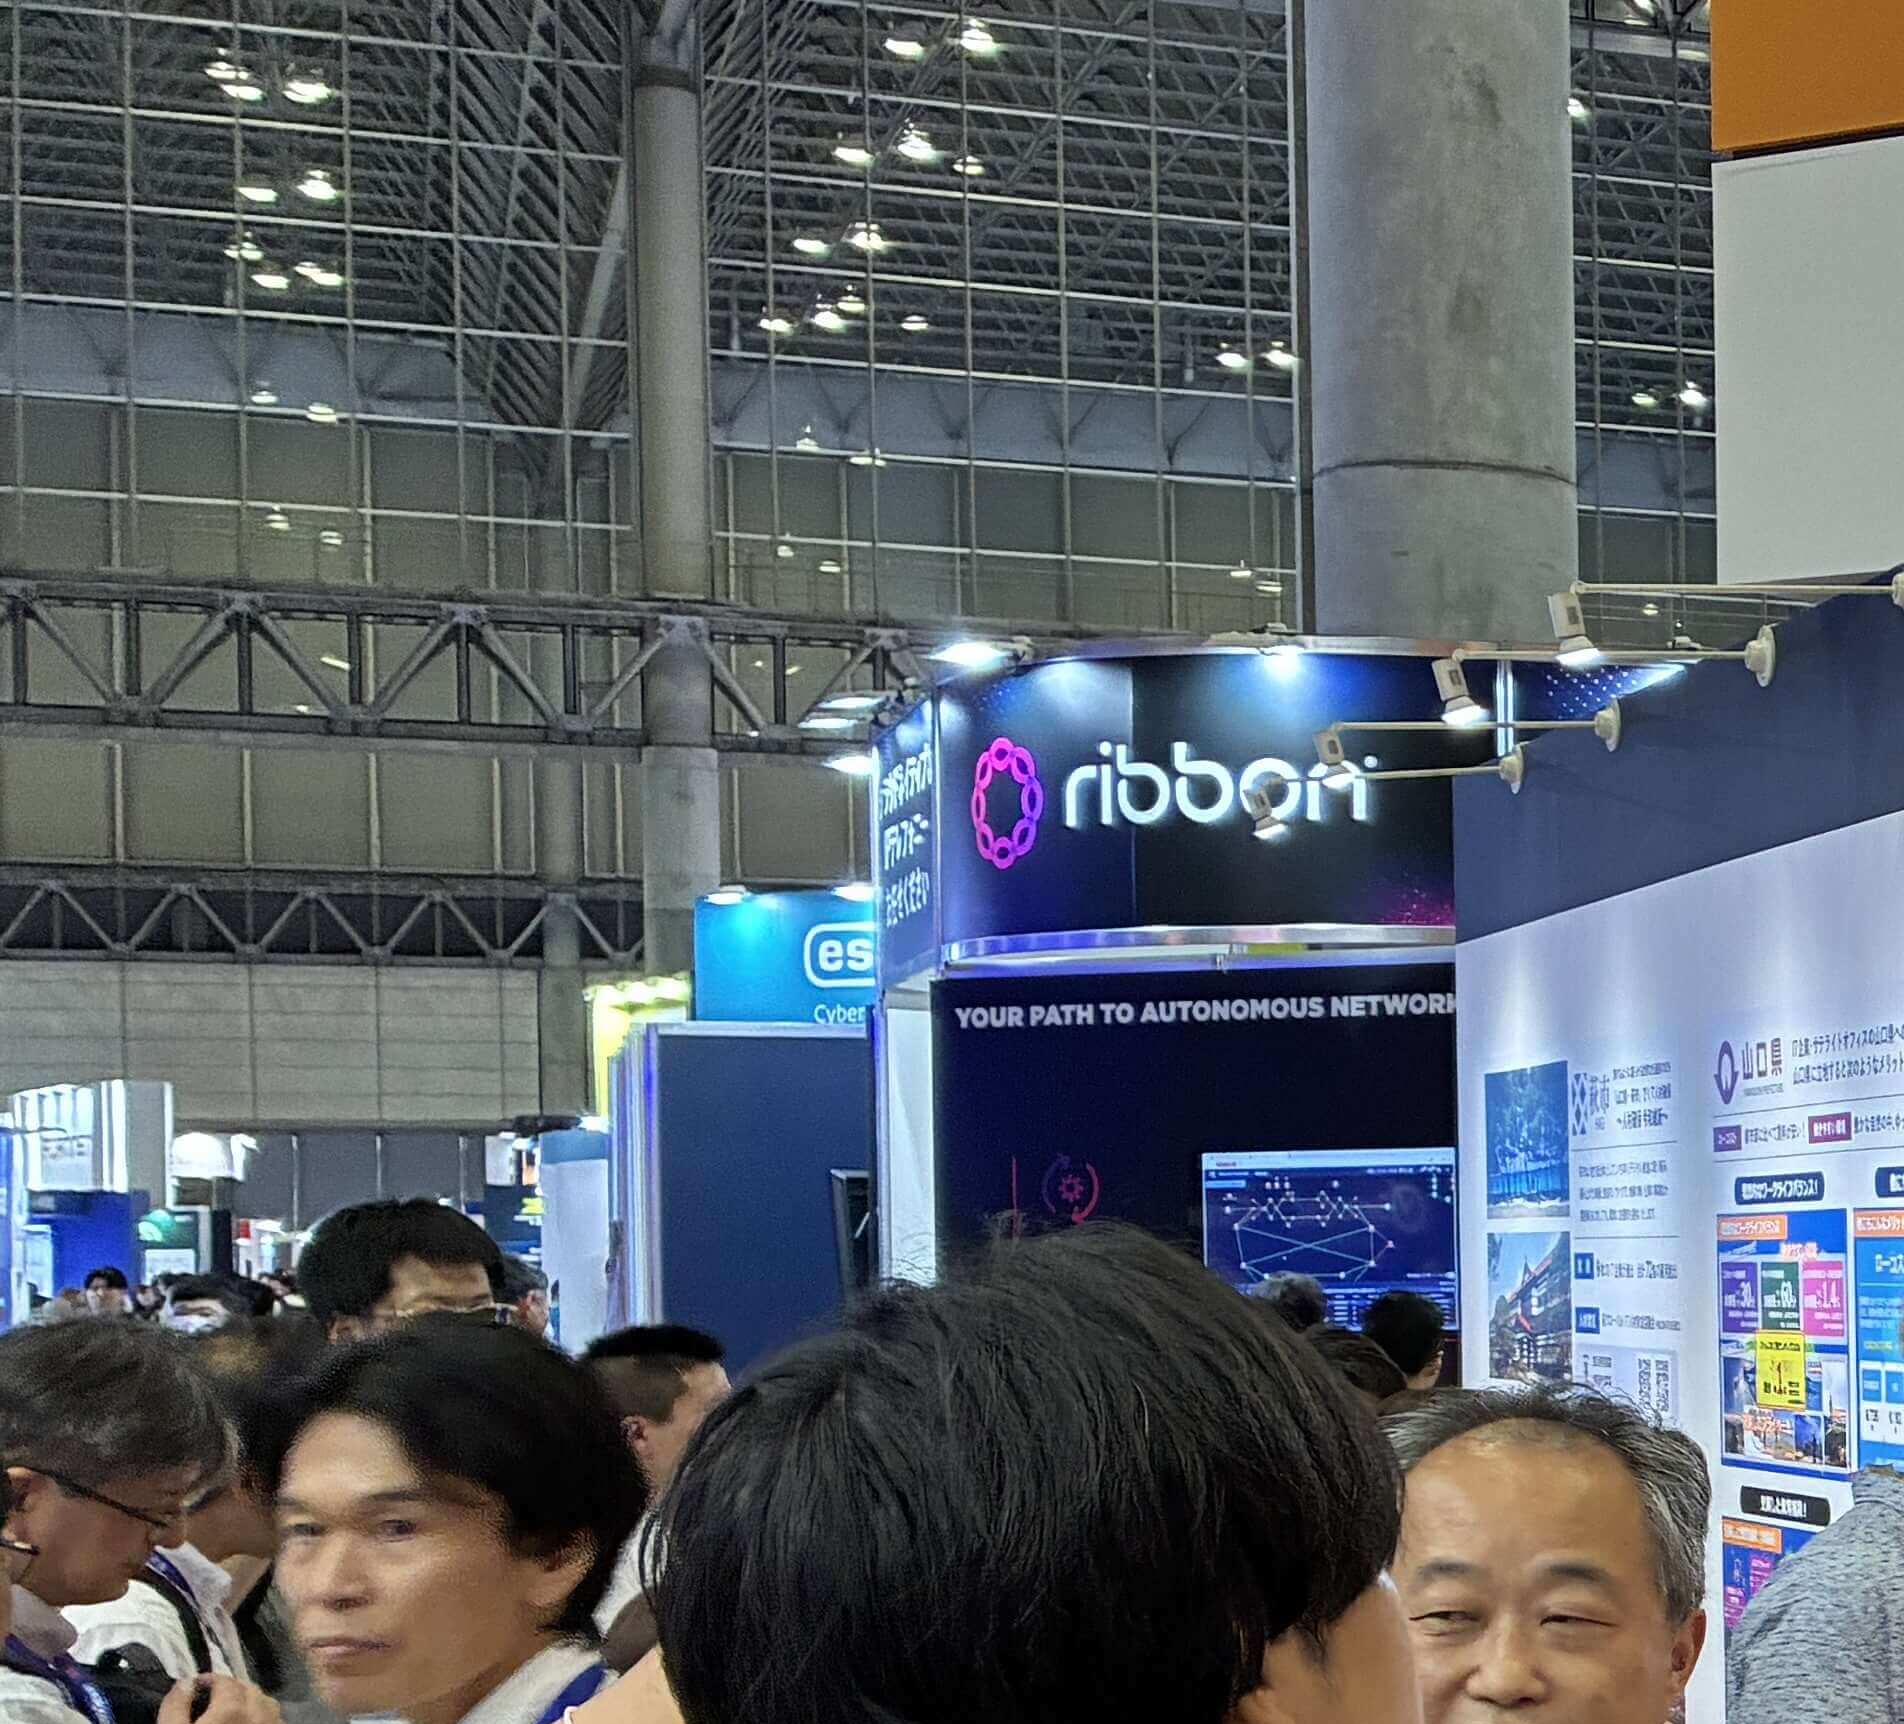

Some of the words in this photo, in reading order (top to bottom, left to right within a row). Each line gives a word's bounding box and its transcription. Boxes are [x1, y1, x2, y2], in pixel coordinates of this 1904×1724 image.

[1064, 740, 1370, 830] ribbon
[819, 939, 874, 973] es
[955, 1005, 1024, 1030] YOUR
[1030, 1003, 1095, 1027] PATH
[1099, 1002, 1135, 1025] TO
[1140, 997, 1325, 1025] AUTONOMOUS
[1742, 1037, 1782, 1080] 山口県
